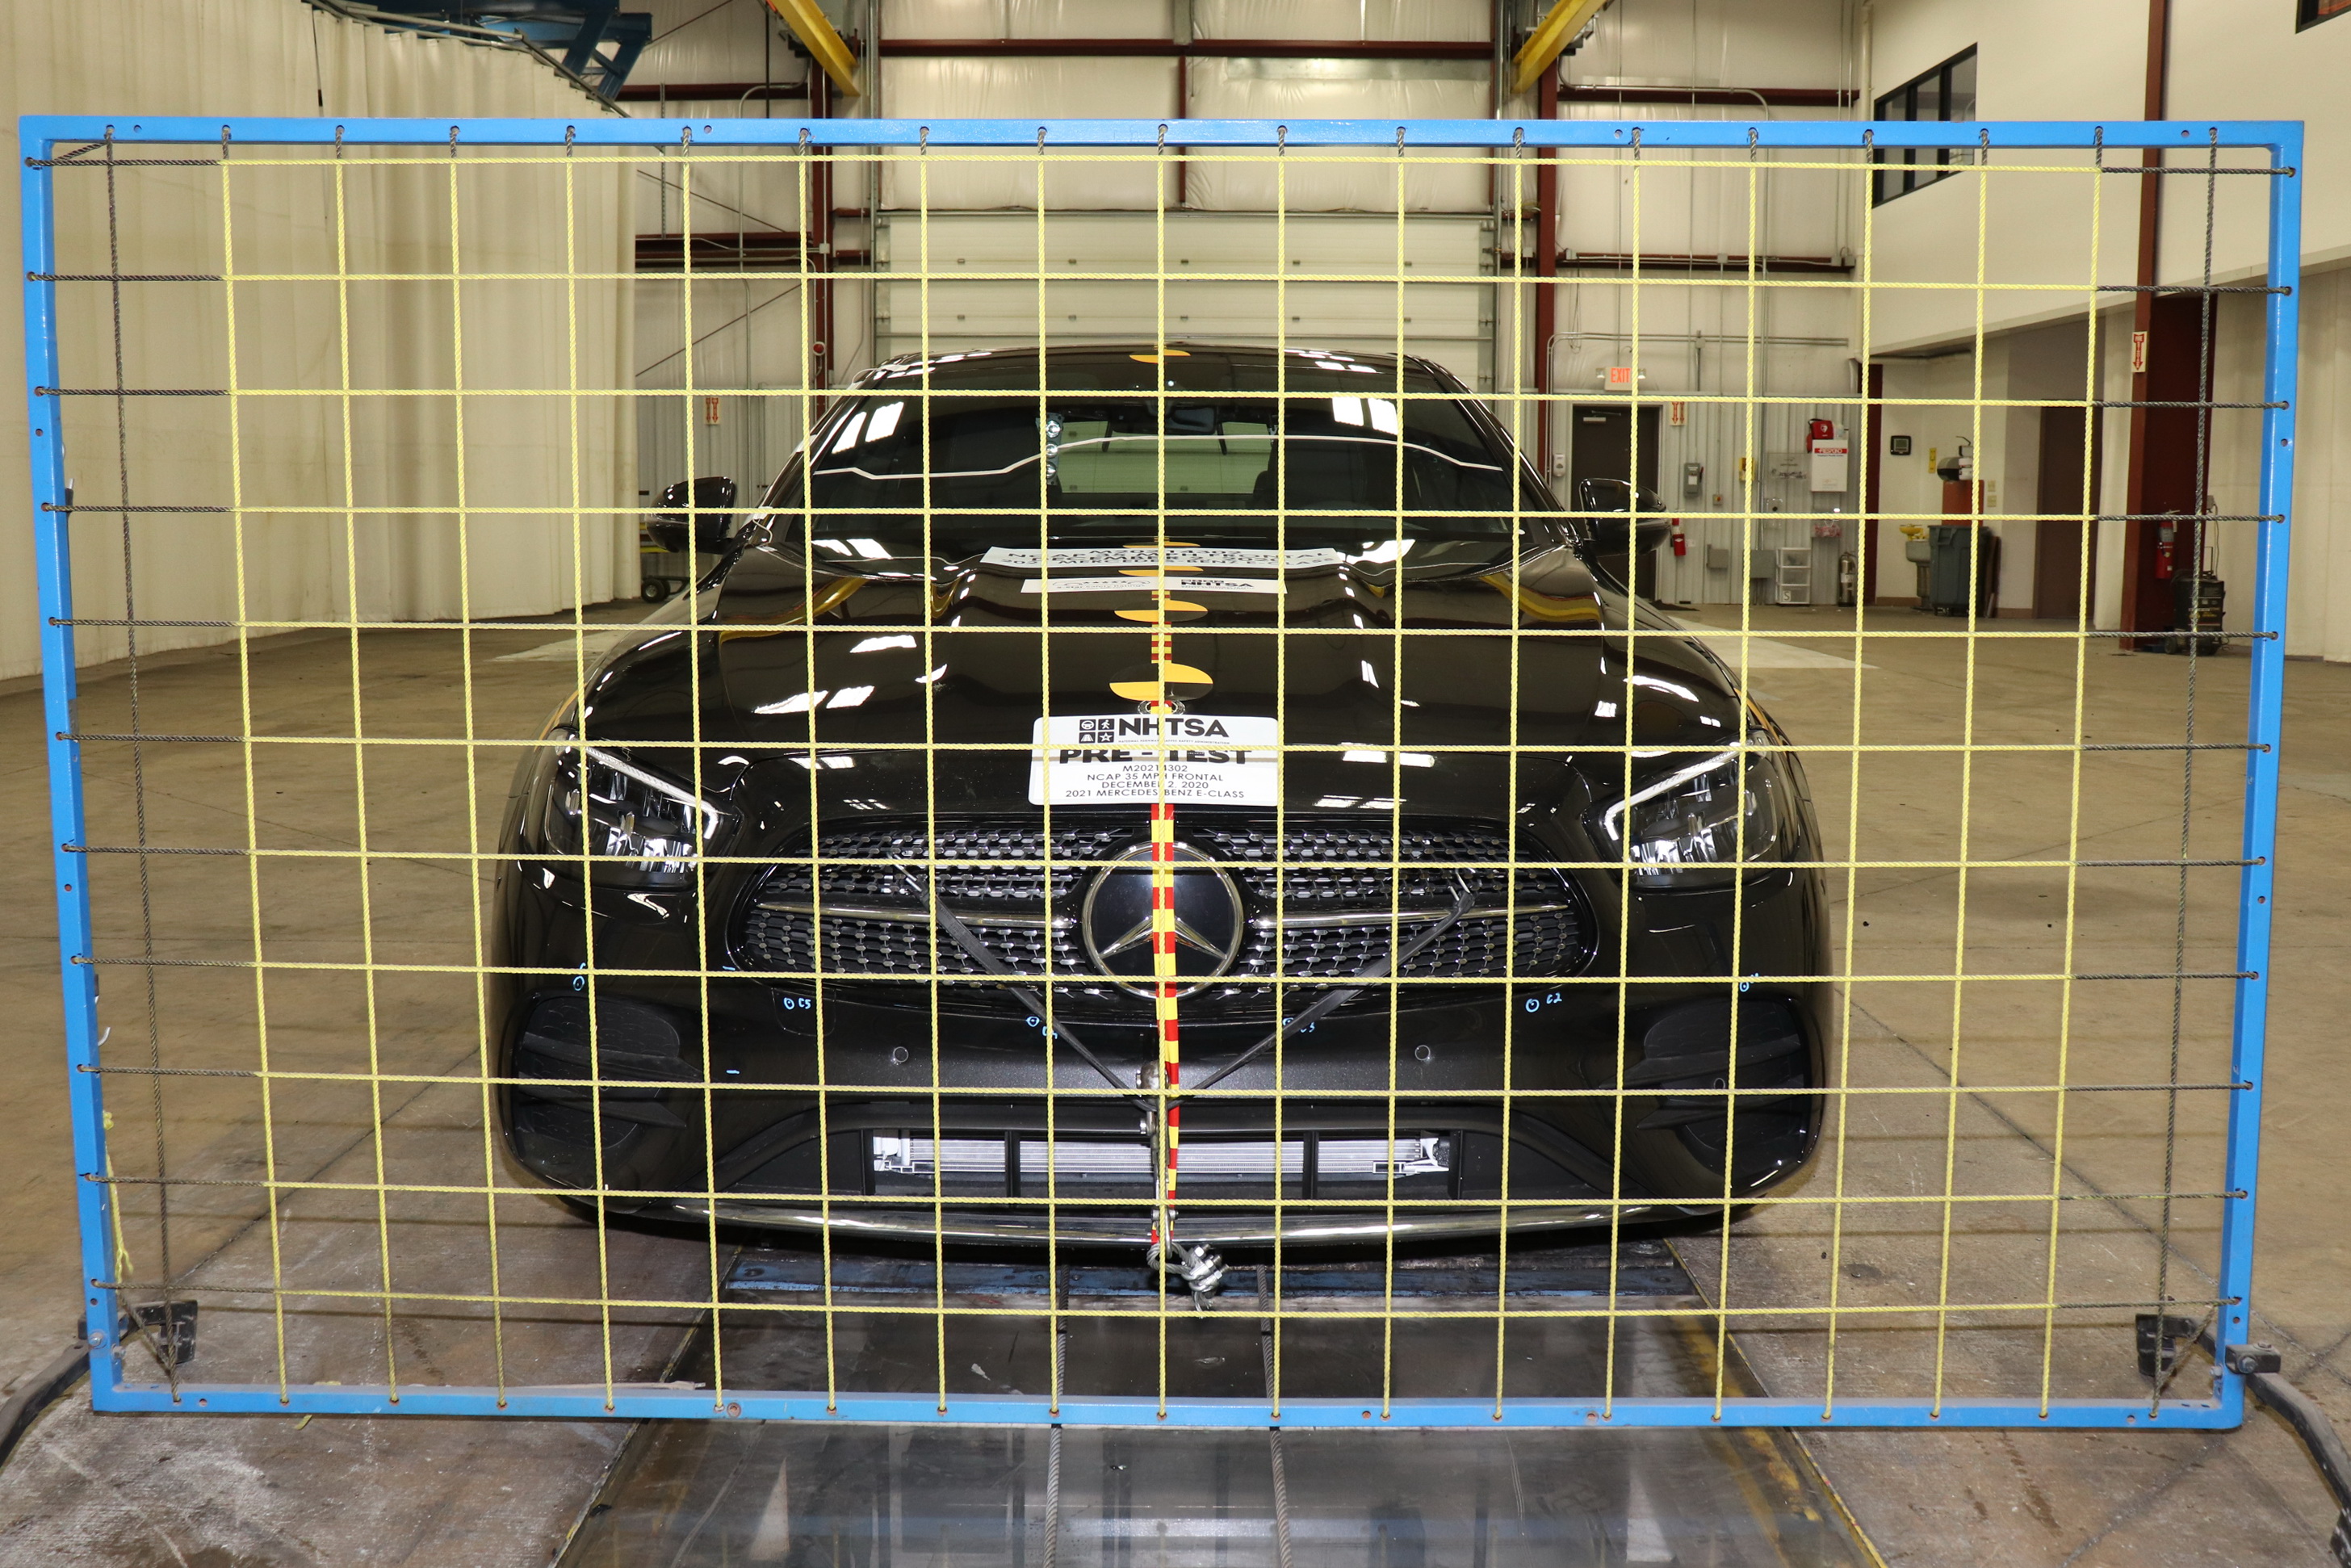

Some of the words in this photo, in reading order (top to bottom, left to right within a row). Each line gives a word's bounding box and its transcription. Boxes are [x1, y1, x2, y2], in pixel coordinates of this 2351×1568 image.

[1611, 367, 1631, 383] EXIT
[1119, 718, 1230, 738] NHTSA
[1171, 773, 1224, 782] FRONTAL
[1066, 790, 1092, 798] 2021
[1196, 790, 1245, 799] E-CLASS
[798, 997, 811, 1009] C5
